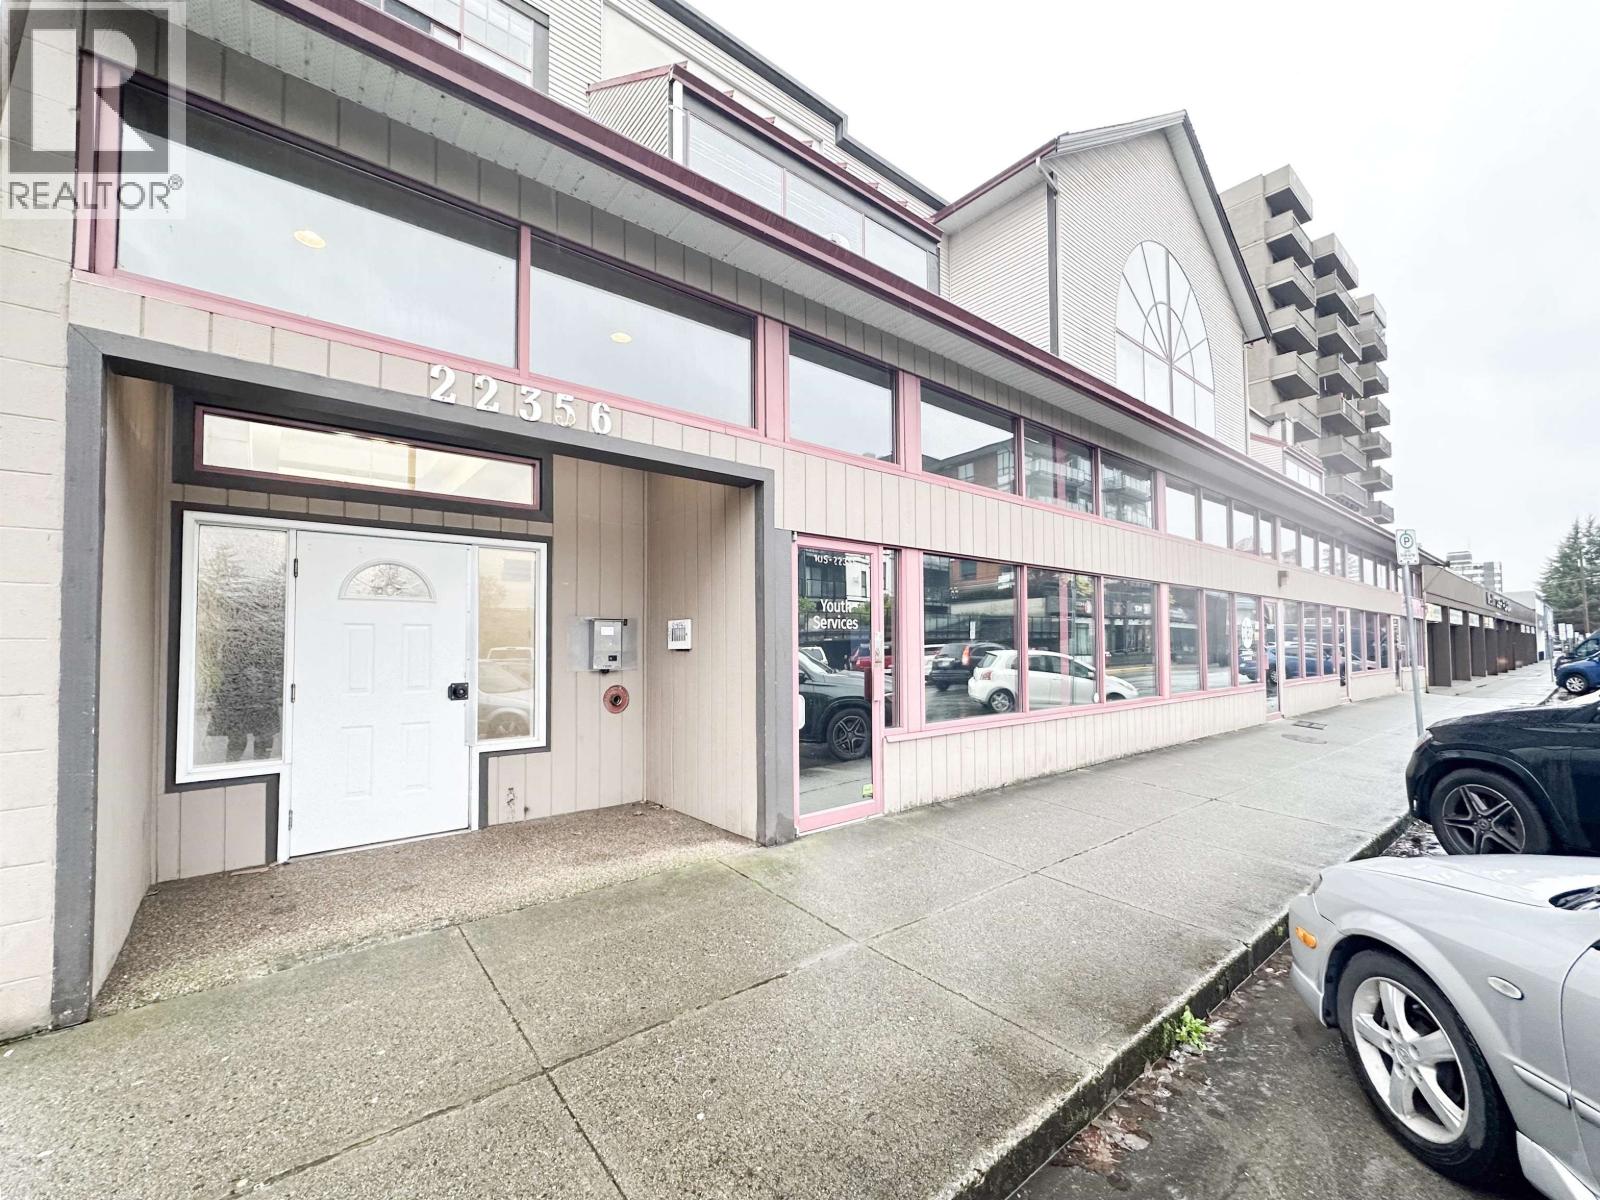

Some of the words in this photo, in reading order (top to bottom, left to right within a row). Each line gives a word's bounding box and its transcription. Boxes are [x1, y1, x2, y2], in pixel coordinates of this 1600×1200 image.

[430, 364, 612, 435] 22356
[820, 599, 852, 613] Youth
[812, 615, 859, 630] Services
